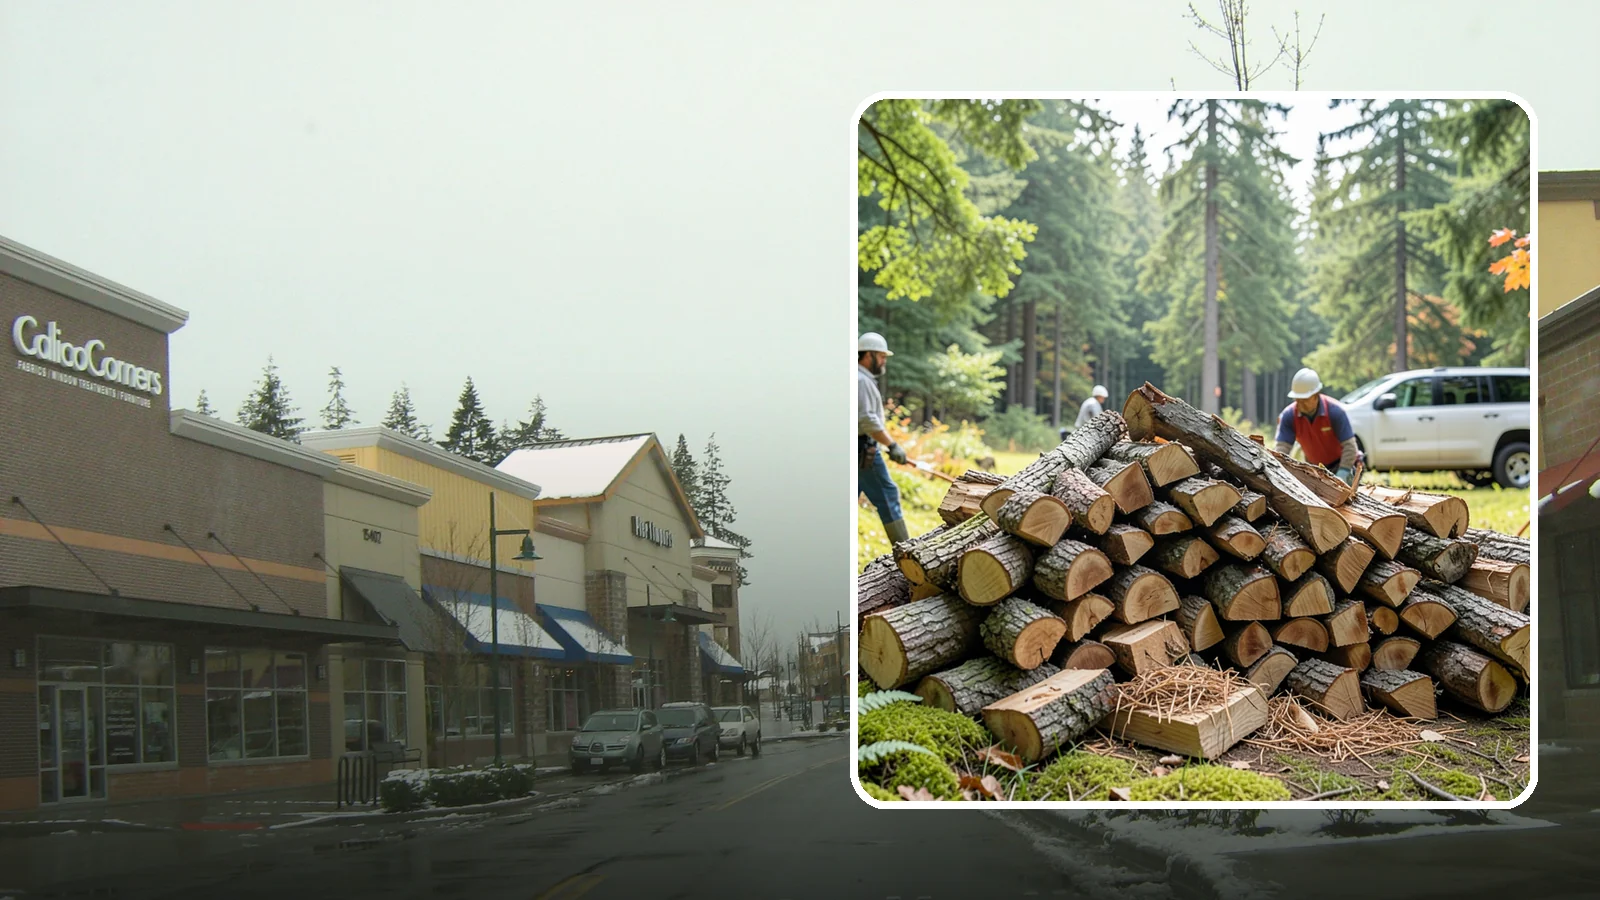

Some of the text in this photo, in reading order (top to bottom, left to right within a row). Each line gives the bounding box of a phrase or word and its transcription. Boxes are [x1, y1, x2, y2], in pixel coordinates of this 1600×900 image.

[16, 360, 47, 377] FABRICS
[51, 370, 77, 386] WINDOW
[78, 378, 116, 398] TREATMENTS
